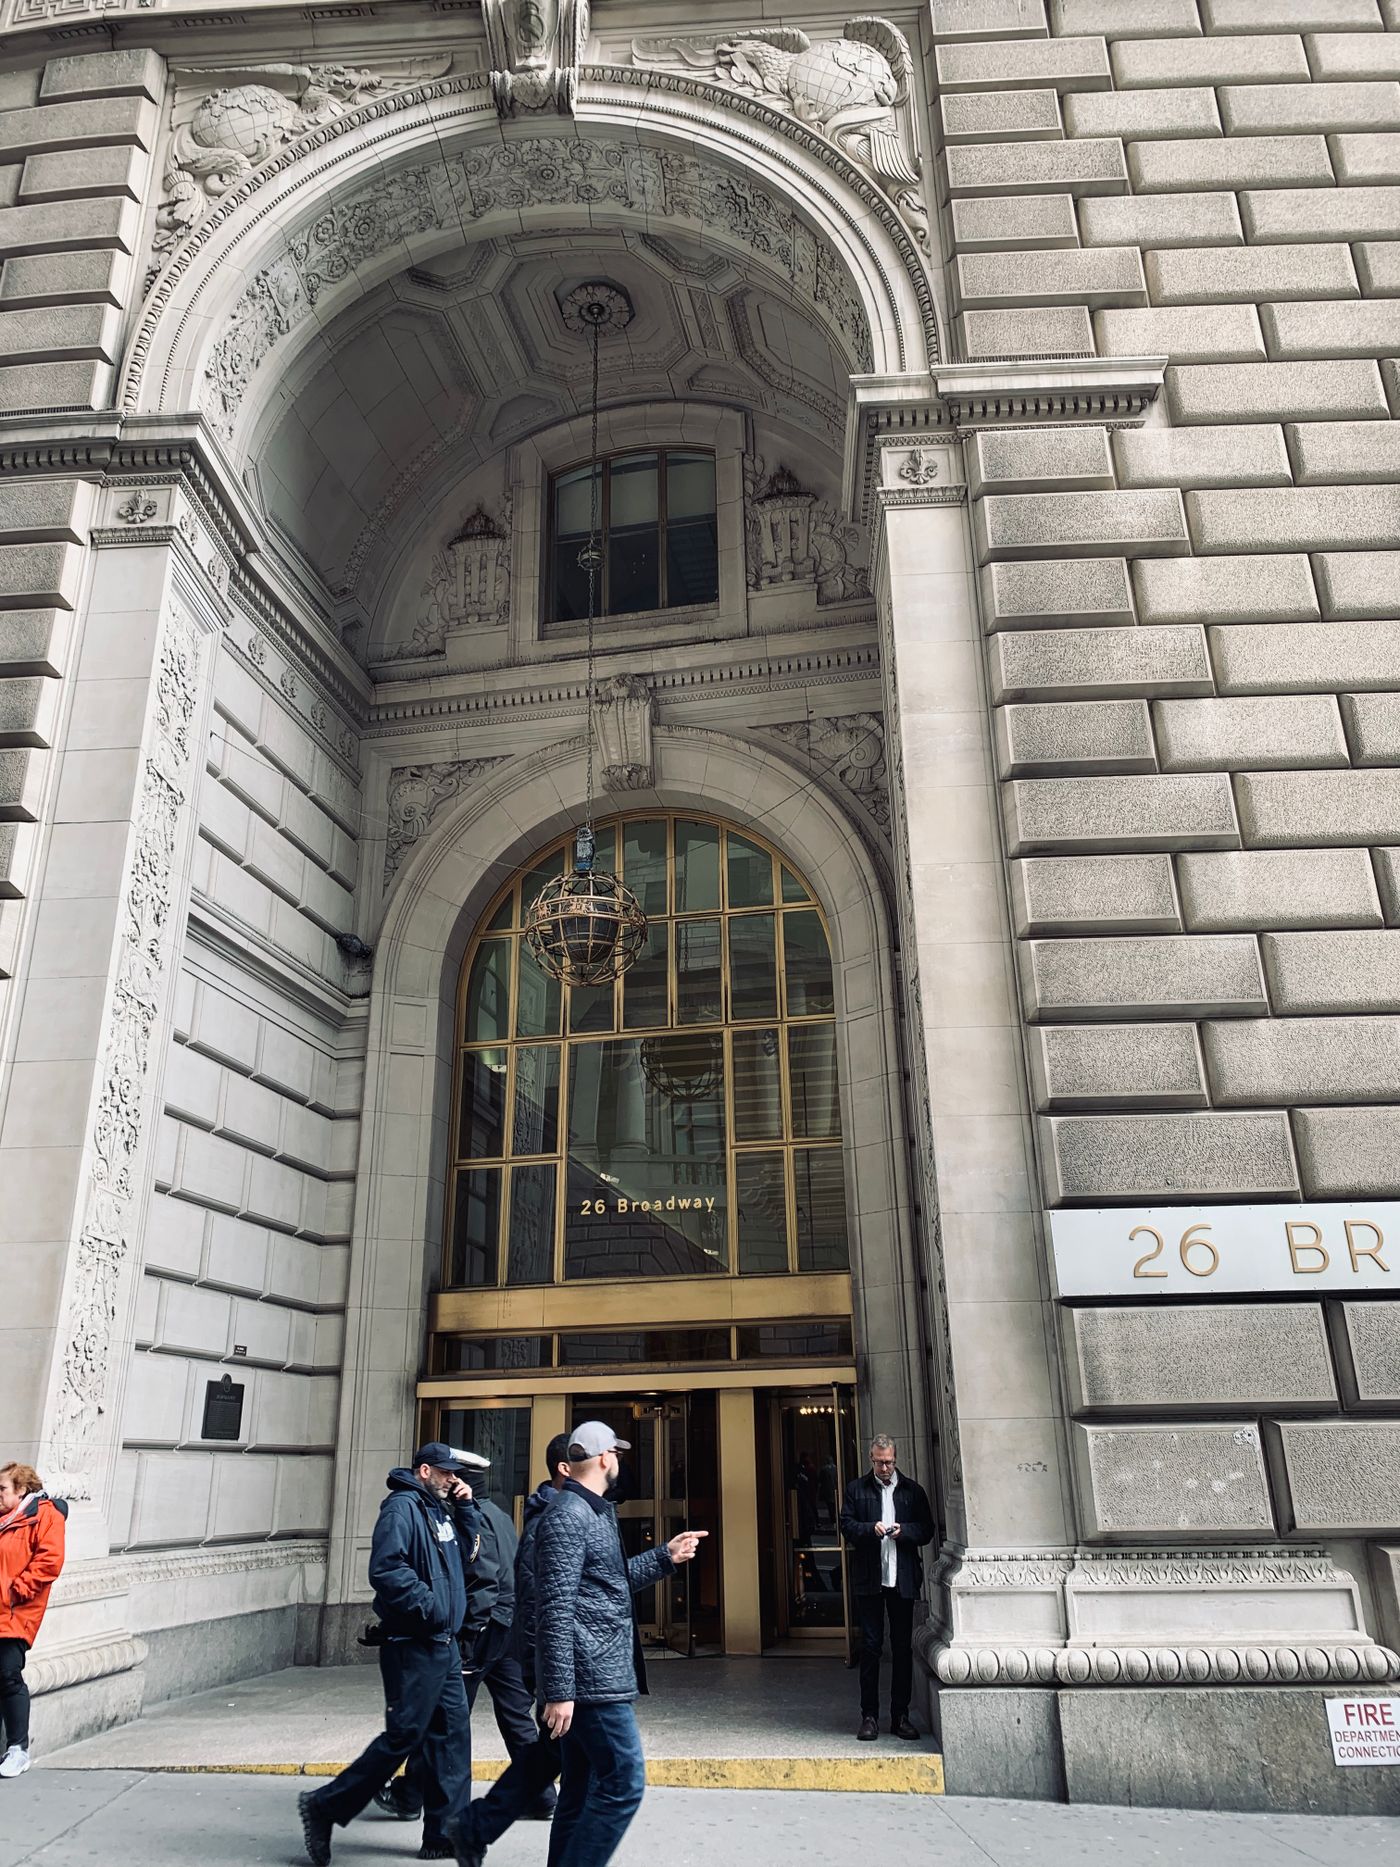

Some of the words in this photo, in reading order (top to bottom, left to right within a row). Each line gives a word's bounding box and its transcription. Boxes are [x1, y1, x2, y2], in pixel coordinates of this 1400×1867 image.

[580, 1199, 606, 1215] 26
[617, 1195, 715, 1213] Broadway
[1128, 1223, 1220, 1278] 26
[1284, 1219, 1391, 1274] BR
[1343, 1703, 1395, 1726] FIRE
